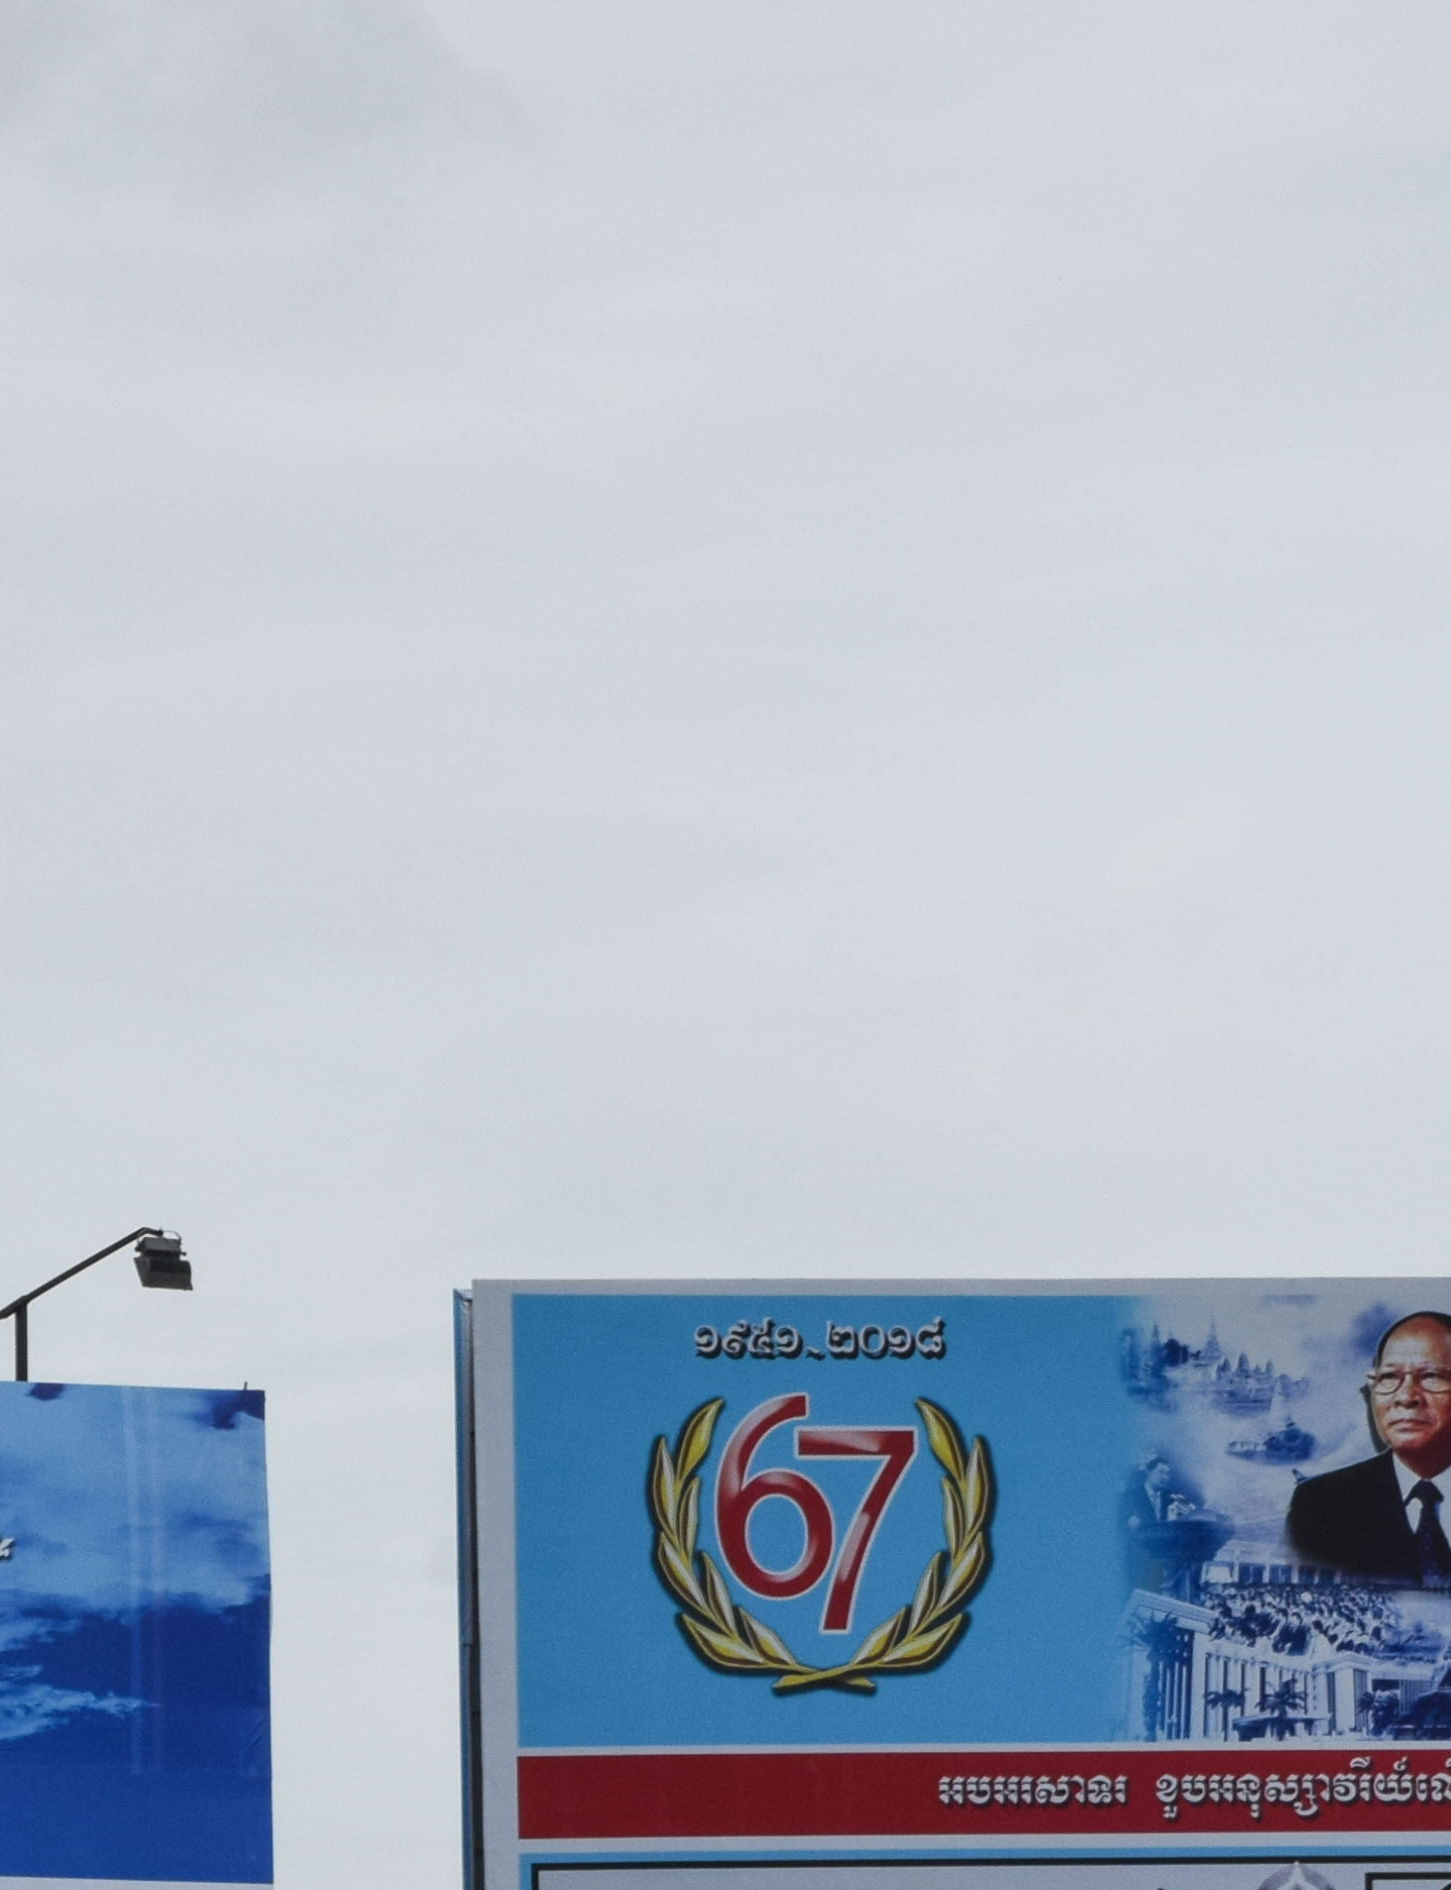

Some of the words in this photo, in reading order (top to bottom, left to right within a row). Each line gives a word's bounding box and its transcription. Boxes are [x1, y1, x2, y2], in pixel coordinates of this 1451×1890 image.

[715, 1392, 918, 1635] 67
[938, 1773, 1129, 1806] អបអរសាទរ
